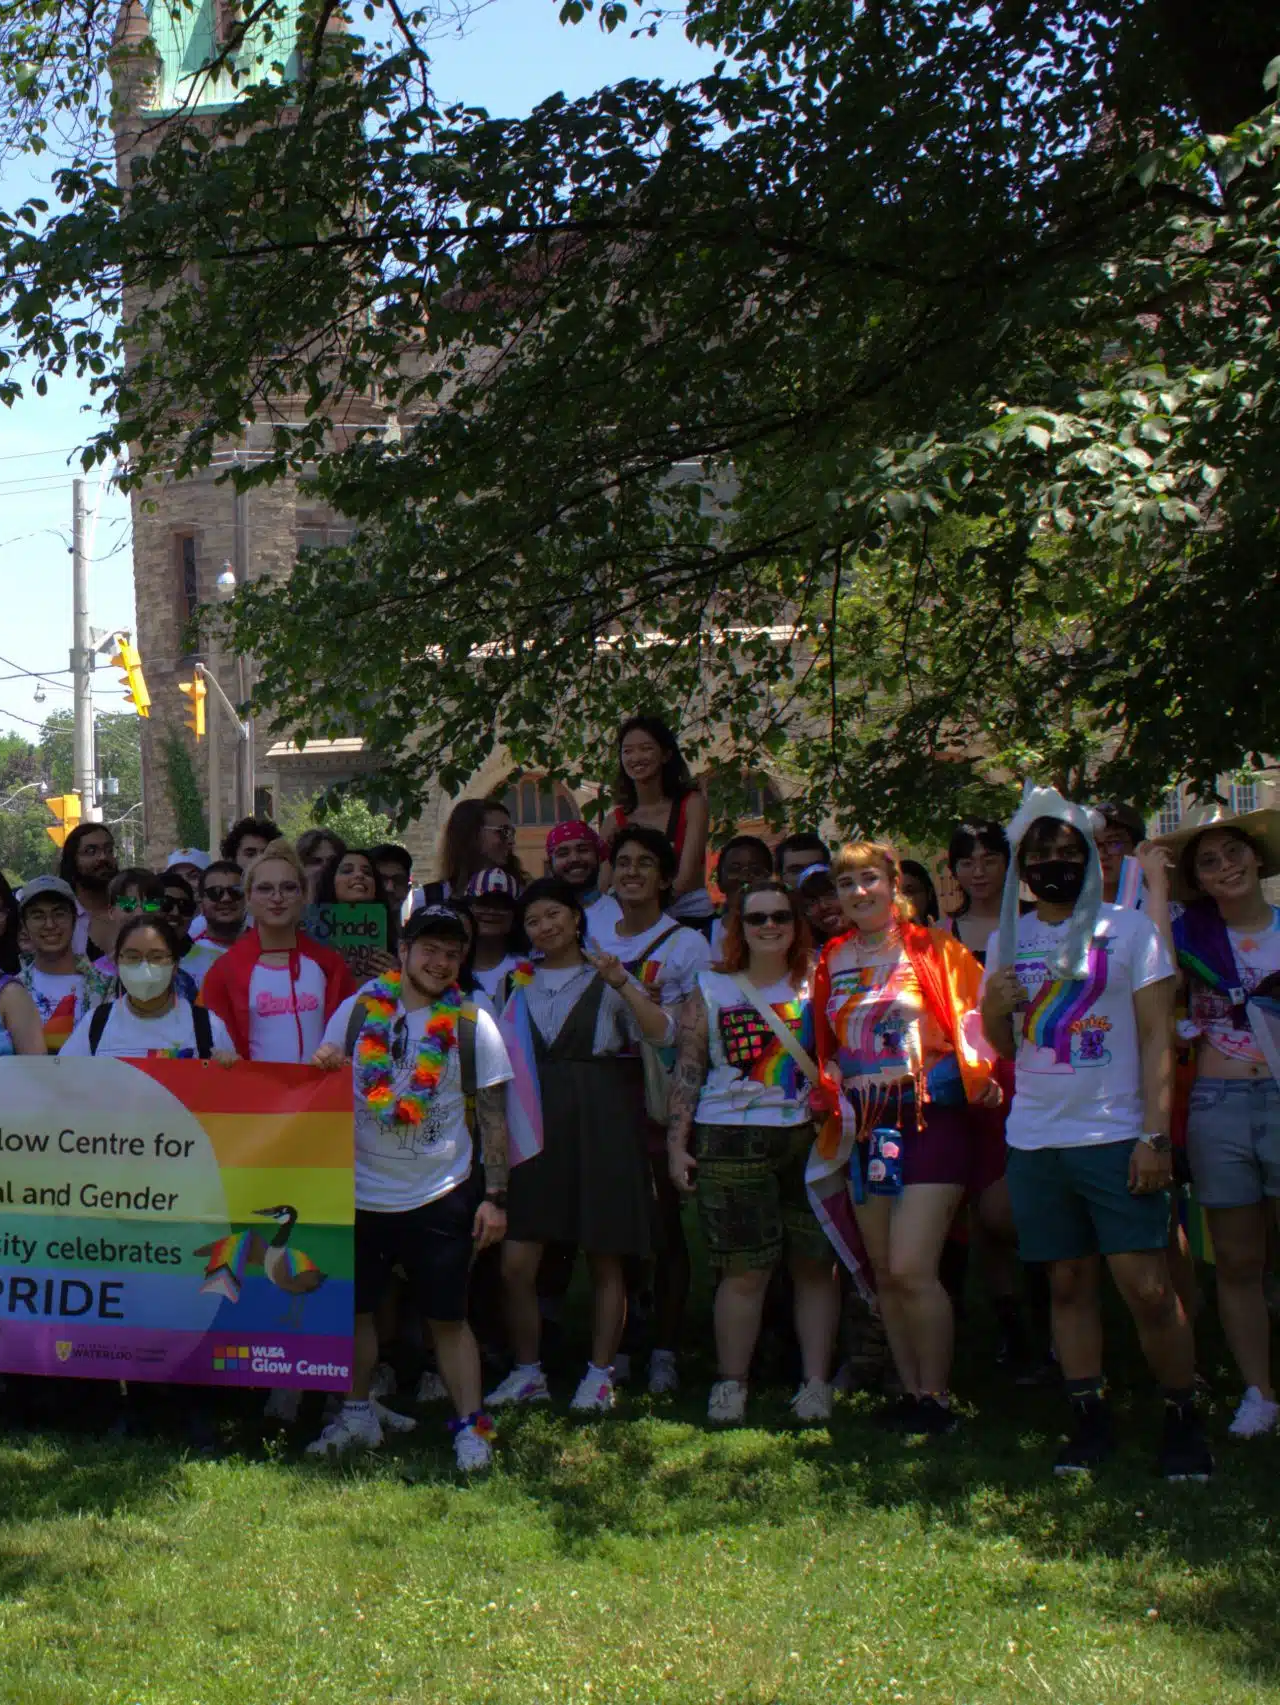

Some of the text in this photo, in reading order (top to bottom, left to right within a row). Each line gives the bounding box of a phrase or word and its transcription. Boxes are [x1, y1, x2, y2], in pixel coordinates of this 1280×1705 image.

[316, 909, 379, 938] Shade
[57, 1128, 145, 1157] Centre
[153, 1131, 195, 1158] for
[22, 1182, 71, 1208] and
[79, 1183, 179, 1211] Gender
[45, 1236, 182, 1266] celebrates
[251, 1357, 350, 1379] Glow Centre
